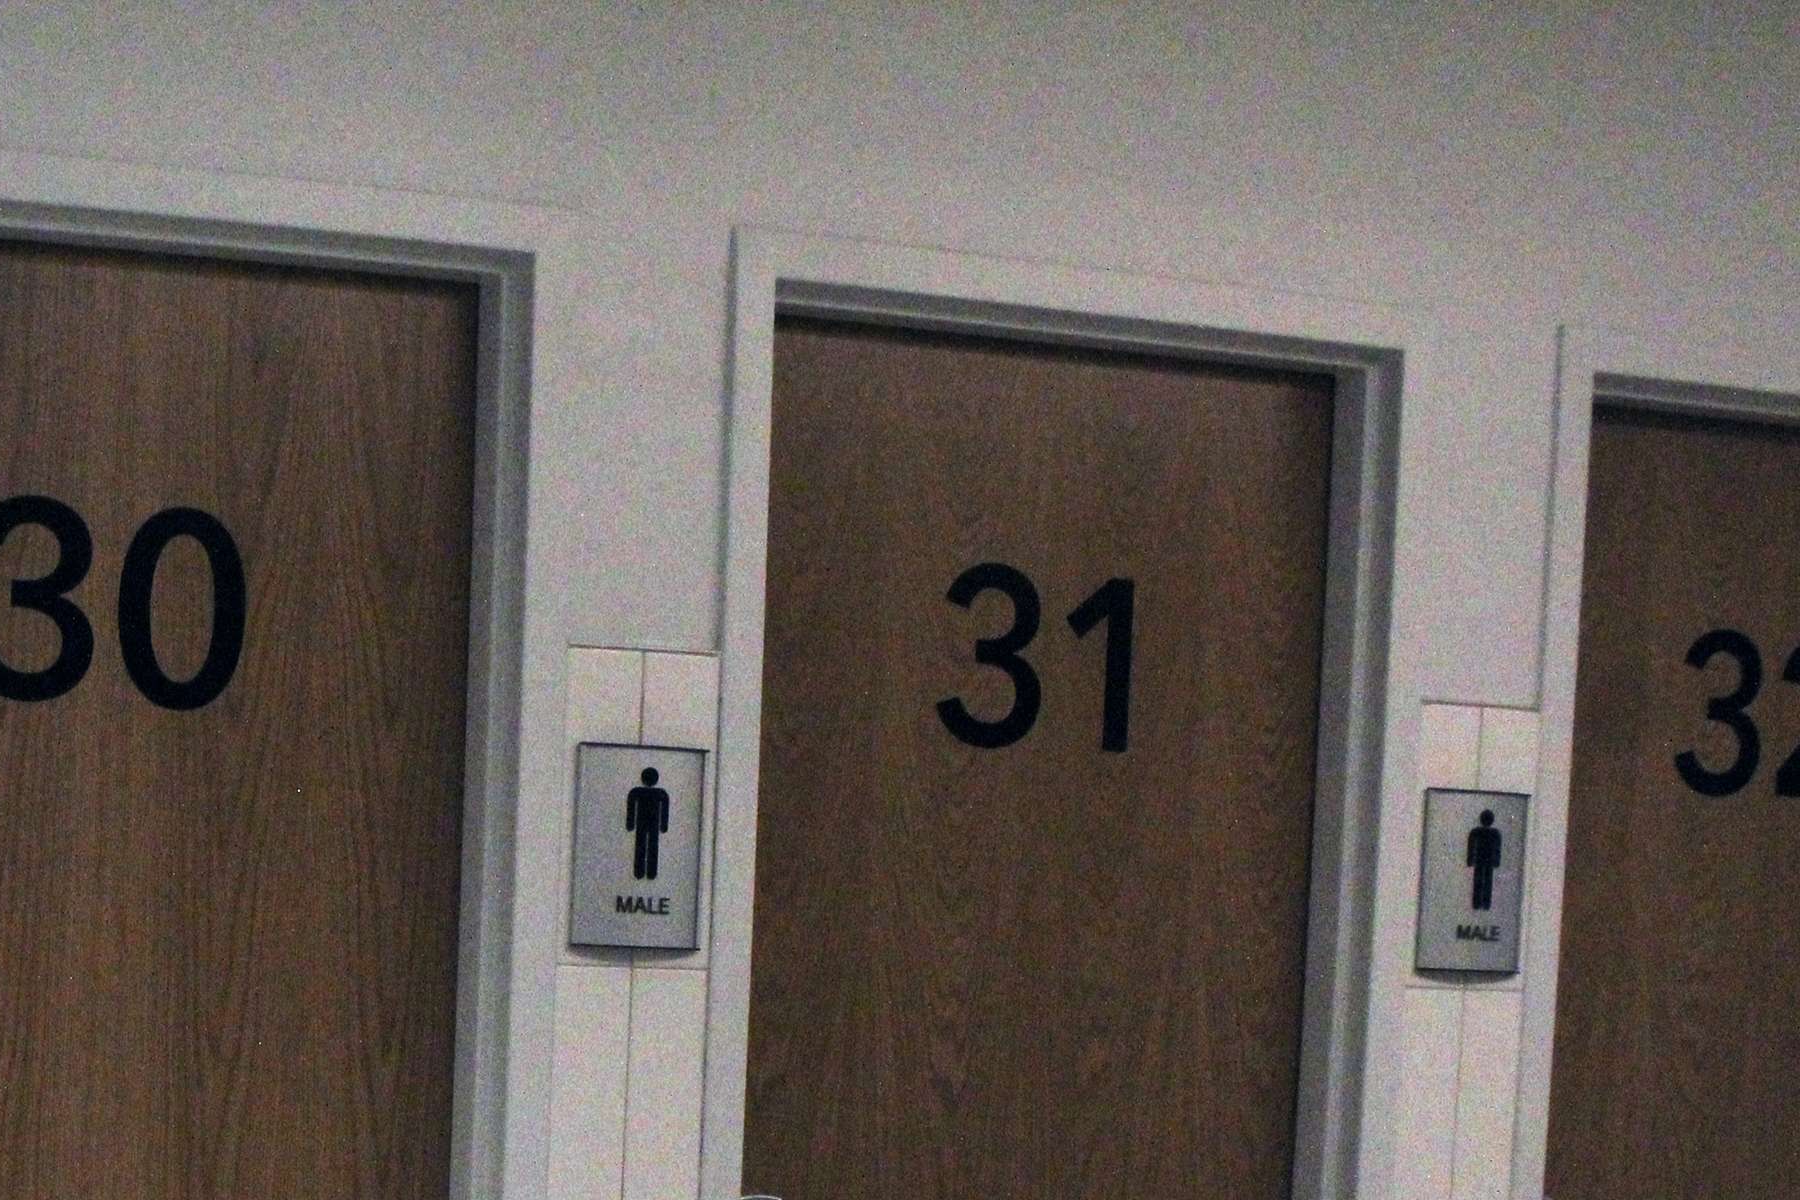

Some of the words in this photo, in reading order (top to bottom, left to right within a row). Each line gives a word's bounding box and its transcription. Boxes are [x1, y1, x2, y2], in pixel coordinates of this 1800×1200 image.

[936, 563, 1135, 753] 31
[1675, 629, 1800, 798] 3
[616, 896, 670, 915] MALE
[1456, 925, 1500, 941] MALE
